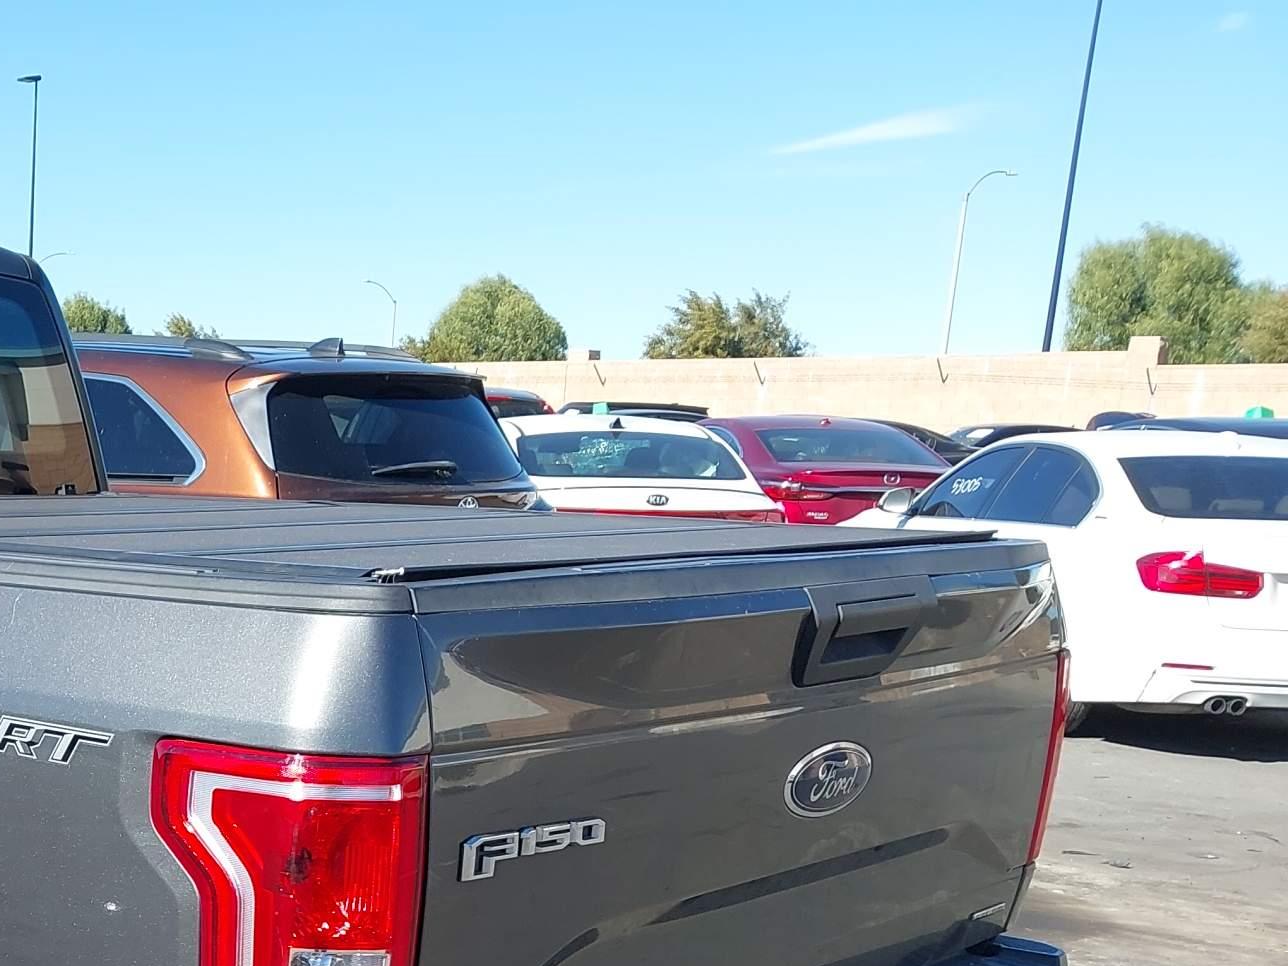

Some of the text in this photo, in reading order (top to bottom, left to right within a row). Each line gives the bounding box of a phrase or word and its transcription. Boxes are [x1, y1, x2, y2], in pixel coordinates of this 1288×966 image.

[647, 495, 669, 505] KIA
[810, 760, 859, 802] Ford
[458, 818, 607, 882] F150
